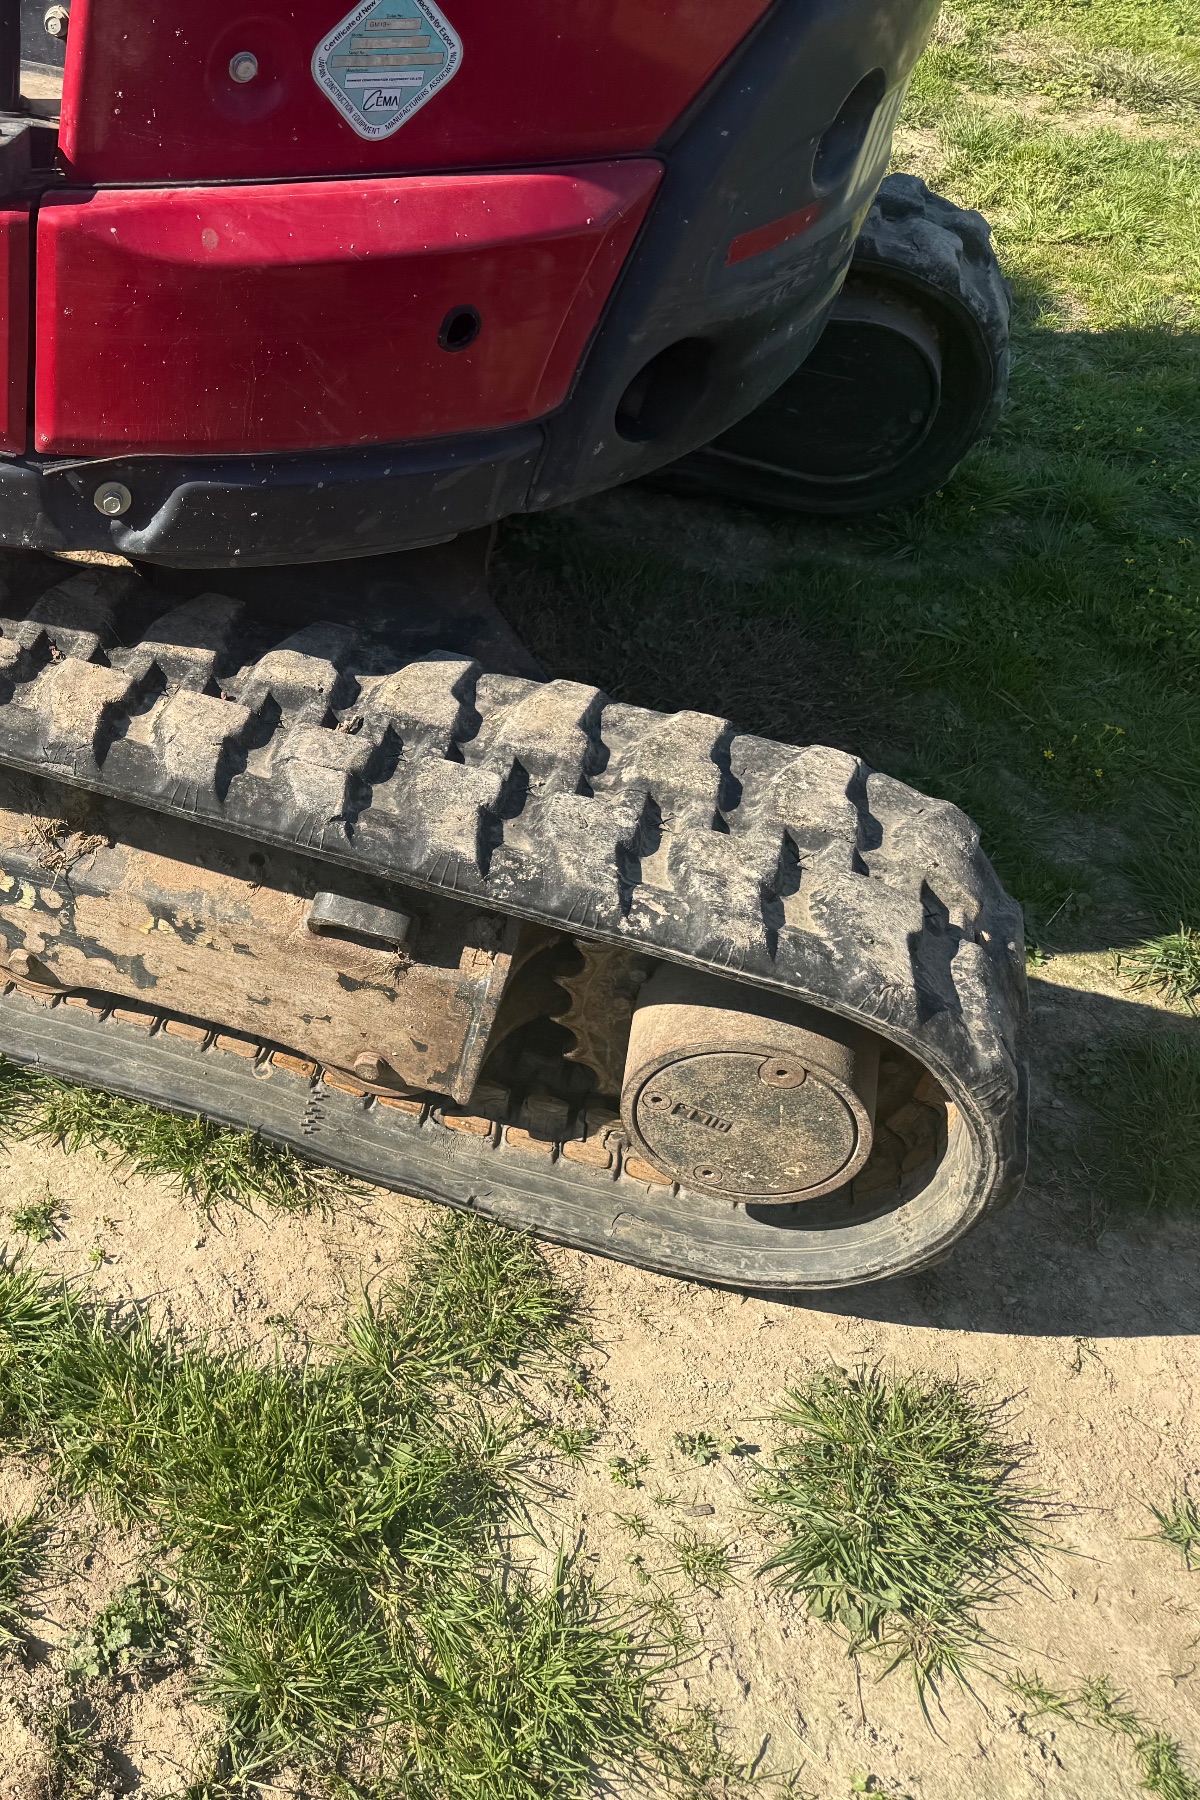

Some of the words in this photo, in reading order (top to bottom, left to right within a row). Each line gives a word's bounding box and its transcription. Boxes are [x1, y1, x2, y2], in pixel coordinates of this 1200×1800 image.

[323, 19, 356, 52] Certificate
[355, 12, 365, 23] of
[432, 19, 442, 29] for
[439, 27, 456, 49] Export
[318, 56, 328, 79] JAPAN
[323, 78, 355, 114] CONSTRUCTION
[352, 113, 381, 135] EQUIPMENT
[362, 89, 399, 111] CEMA
[384, 89, 430, 131] MANUFACTURERS
[429, 51, 458, 91] ASSOCIATION
